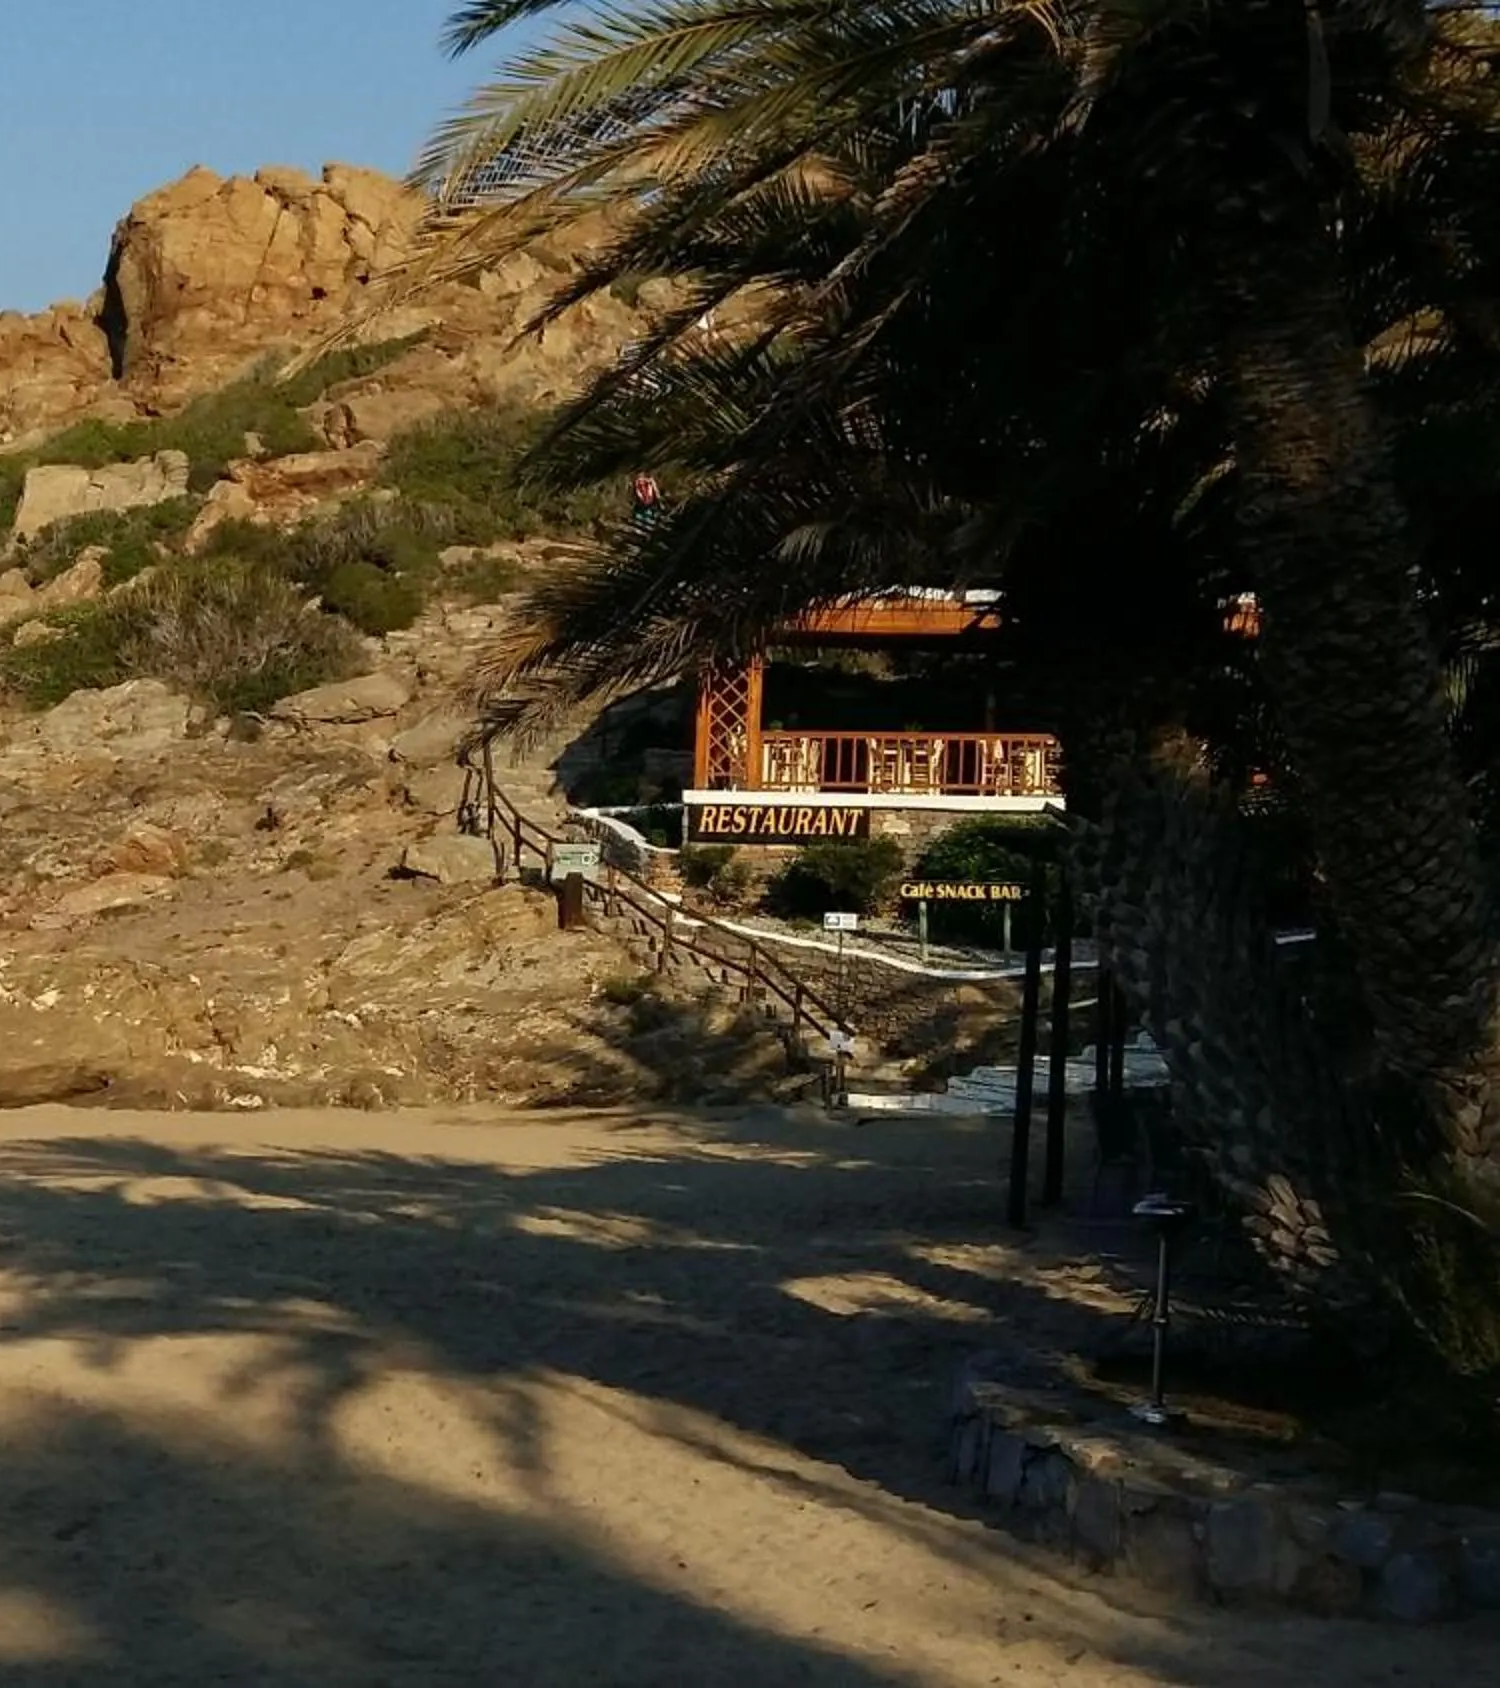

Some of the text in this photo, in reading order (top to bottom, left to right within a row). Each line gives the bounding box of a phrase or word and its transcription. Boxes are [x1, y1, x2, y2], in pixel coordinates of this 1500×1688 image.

[698, 805, 863, 836] RESTAURANT
[935, 883, 987, 899] SNACK
[990, 884, 1022, 900] BAR
